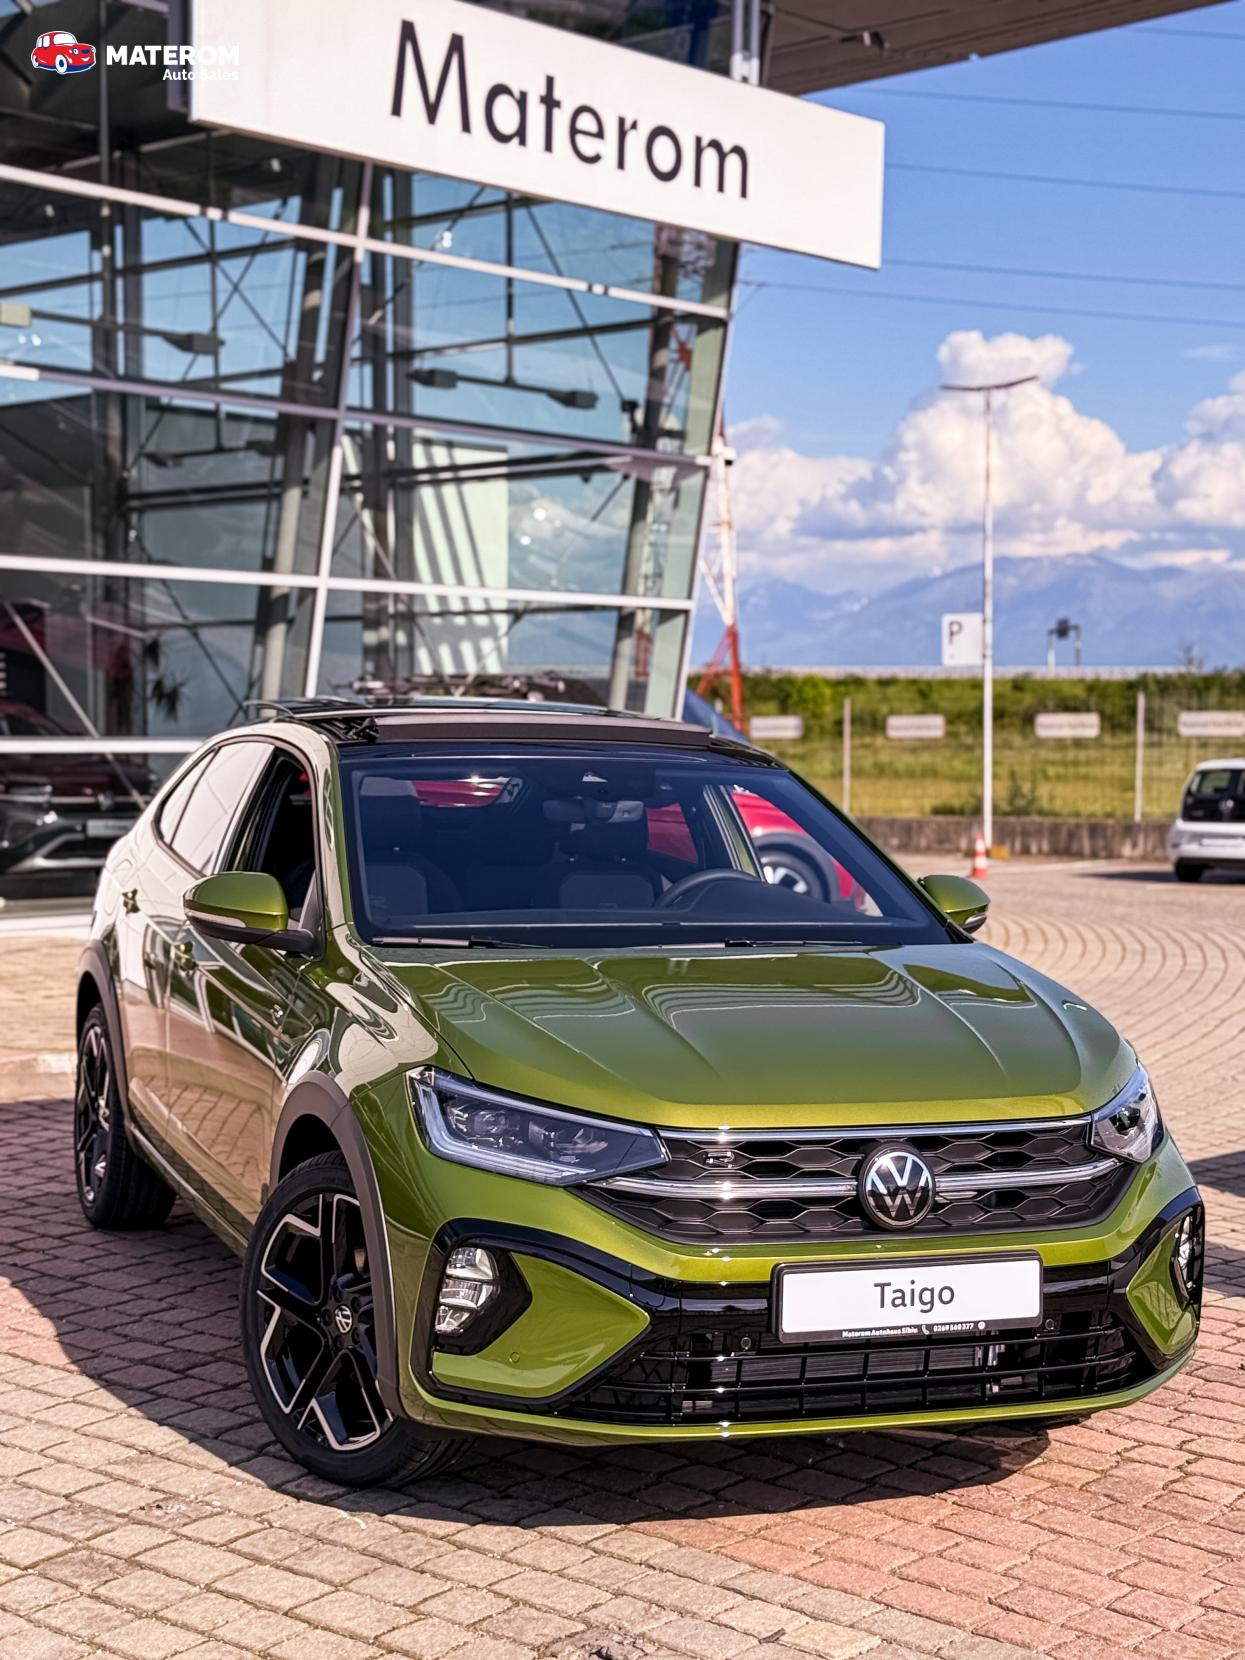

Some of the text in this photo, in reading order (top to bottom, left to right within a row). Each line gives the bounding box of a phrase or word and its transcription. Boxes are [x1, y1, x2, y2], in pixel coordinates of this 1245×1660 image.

[391, 19, 749, 199] Materom
[949, 621, 963, 645] P
[865, 1151, 932, 1224] VW
[874, 1279, 955, 1313] Taigo
[902, 1326, 918, 1334] Sibiu
